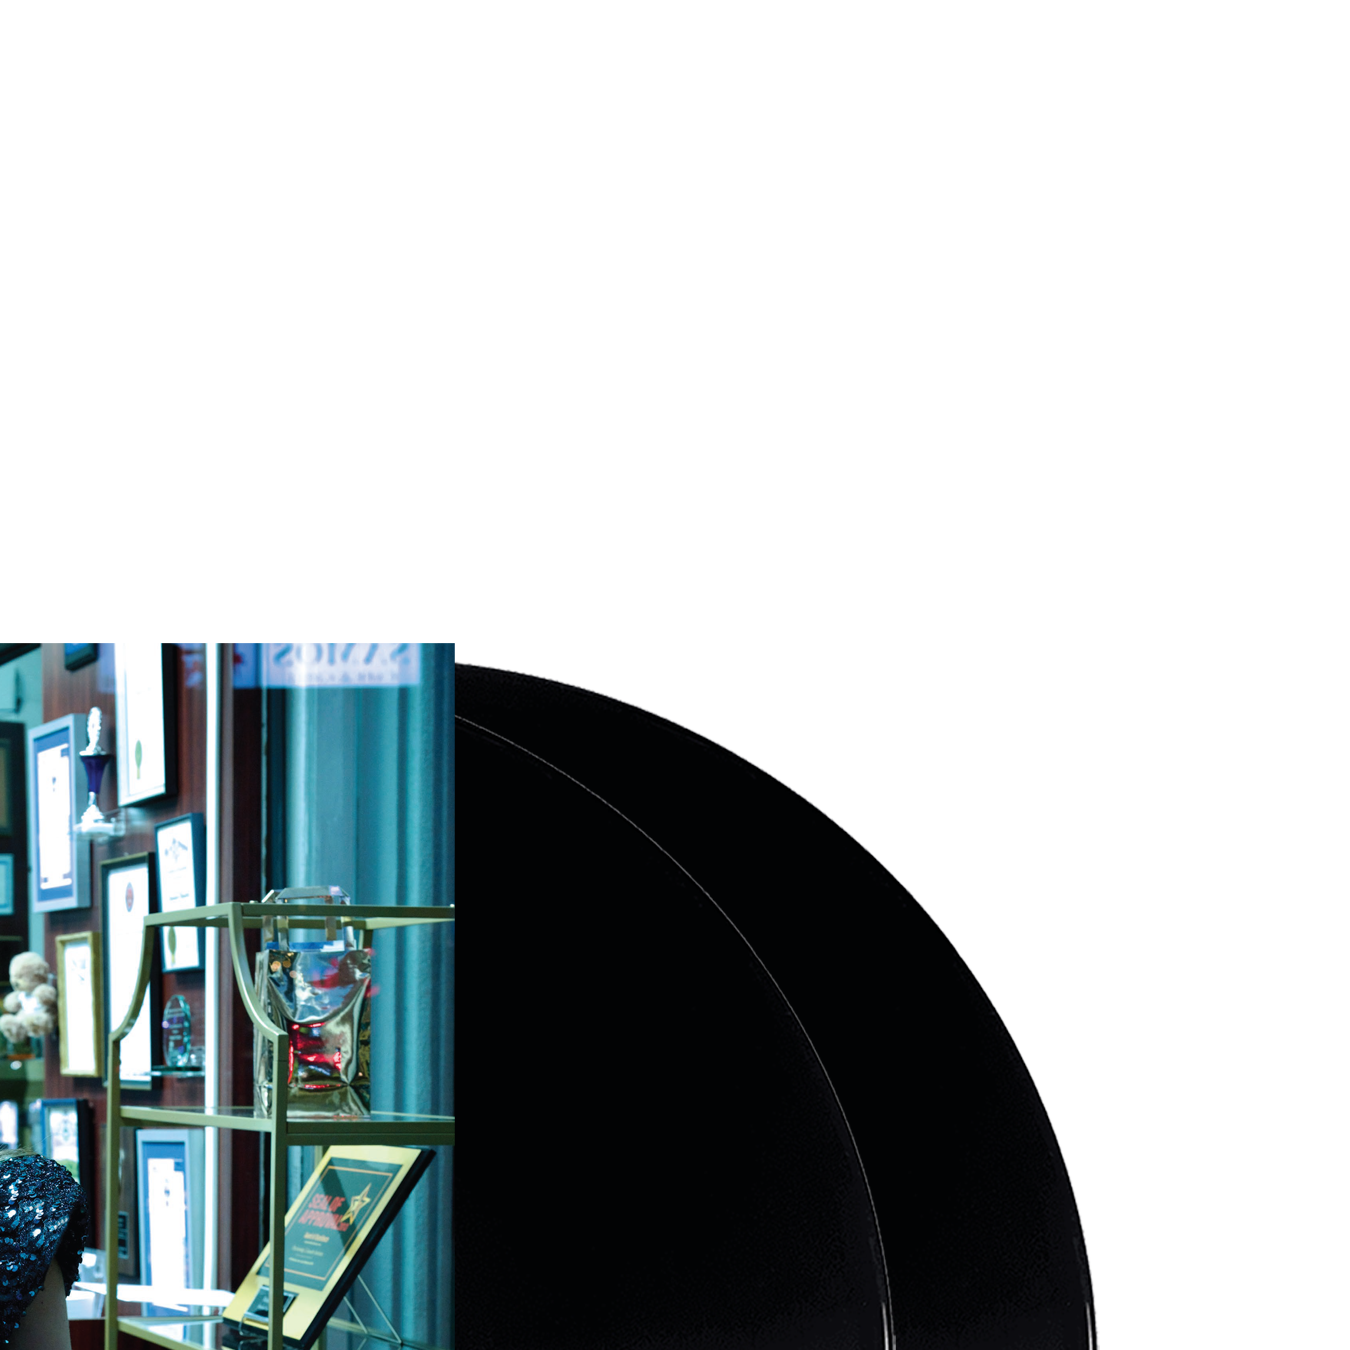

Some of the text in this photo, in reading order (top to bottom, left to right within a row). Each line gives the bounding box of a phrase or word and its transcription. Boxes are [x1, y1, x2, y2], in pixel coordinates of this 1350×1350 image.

[309, 1194, 345, 1212] SEAL OF
[299, 1210, 343, 1230] APPROVAL
